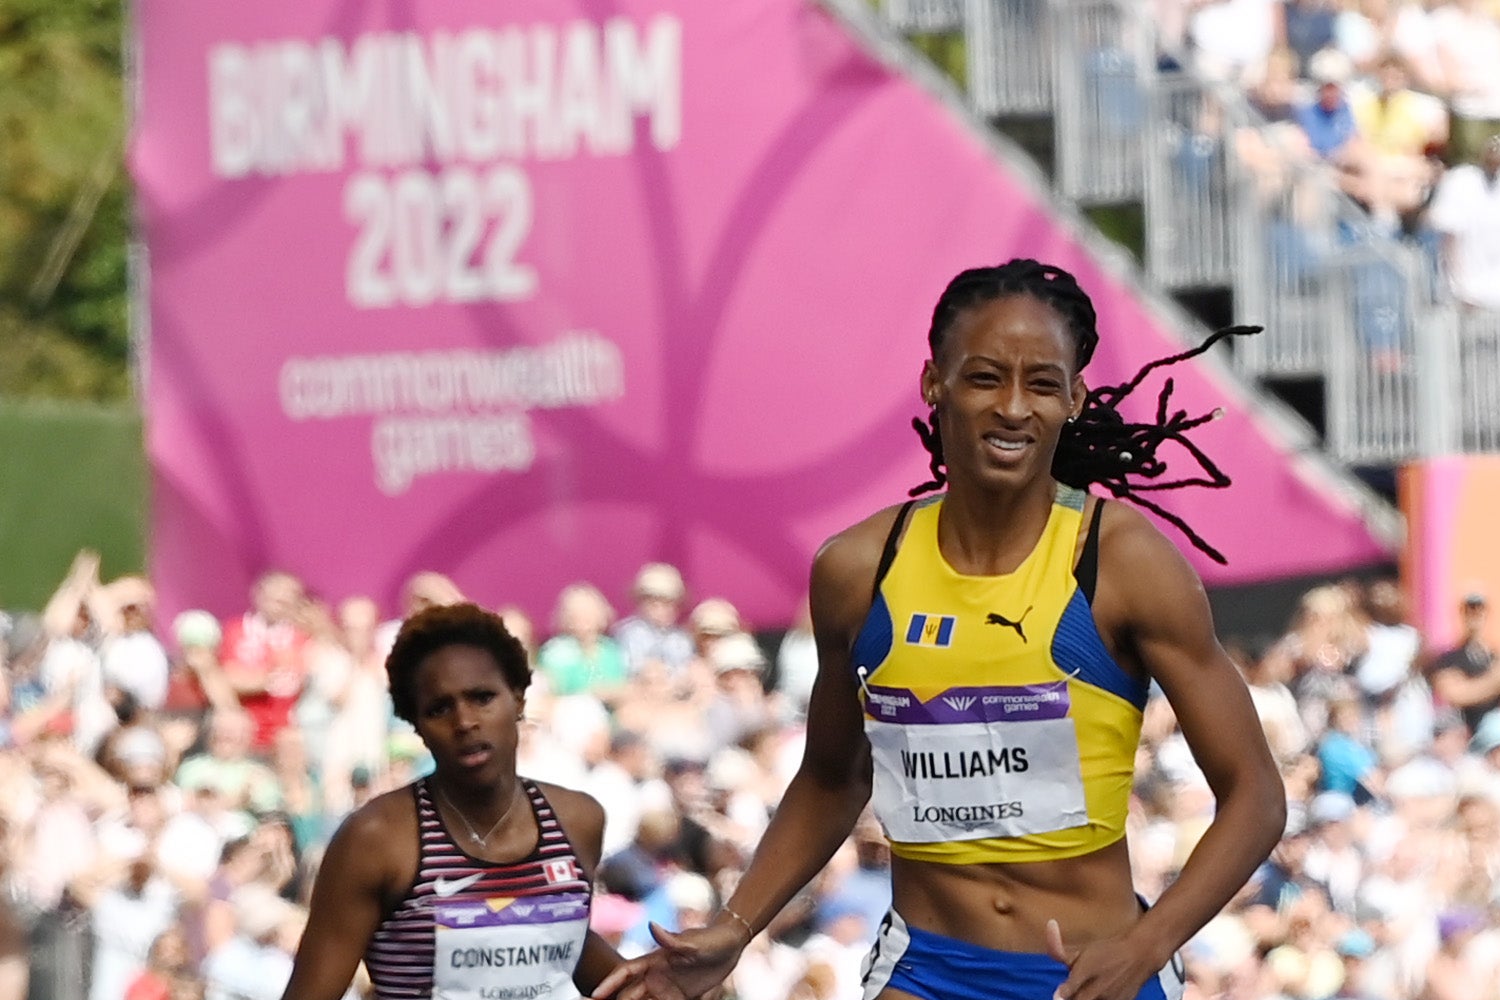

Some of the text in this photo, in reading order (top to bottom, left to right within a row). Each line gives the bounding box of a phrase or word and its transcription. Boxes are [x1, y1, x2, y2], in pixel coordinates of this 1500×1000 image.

[210, 18, 682, 176] BIRMINGHAM
[345, 165, 537, 306] 2022
[982, 692, 1059, 704] commonwealth
[1004, 703, 1038, 714] games
[901, 748, 1029, 779] WILLIAMS
[912, 802, 1024, 823] LONGINES
[451, 941, 574, 968] CONSTANTINE
